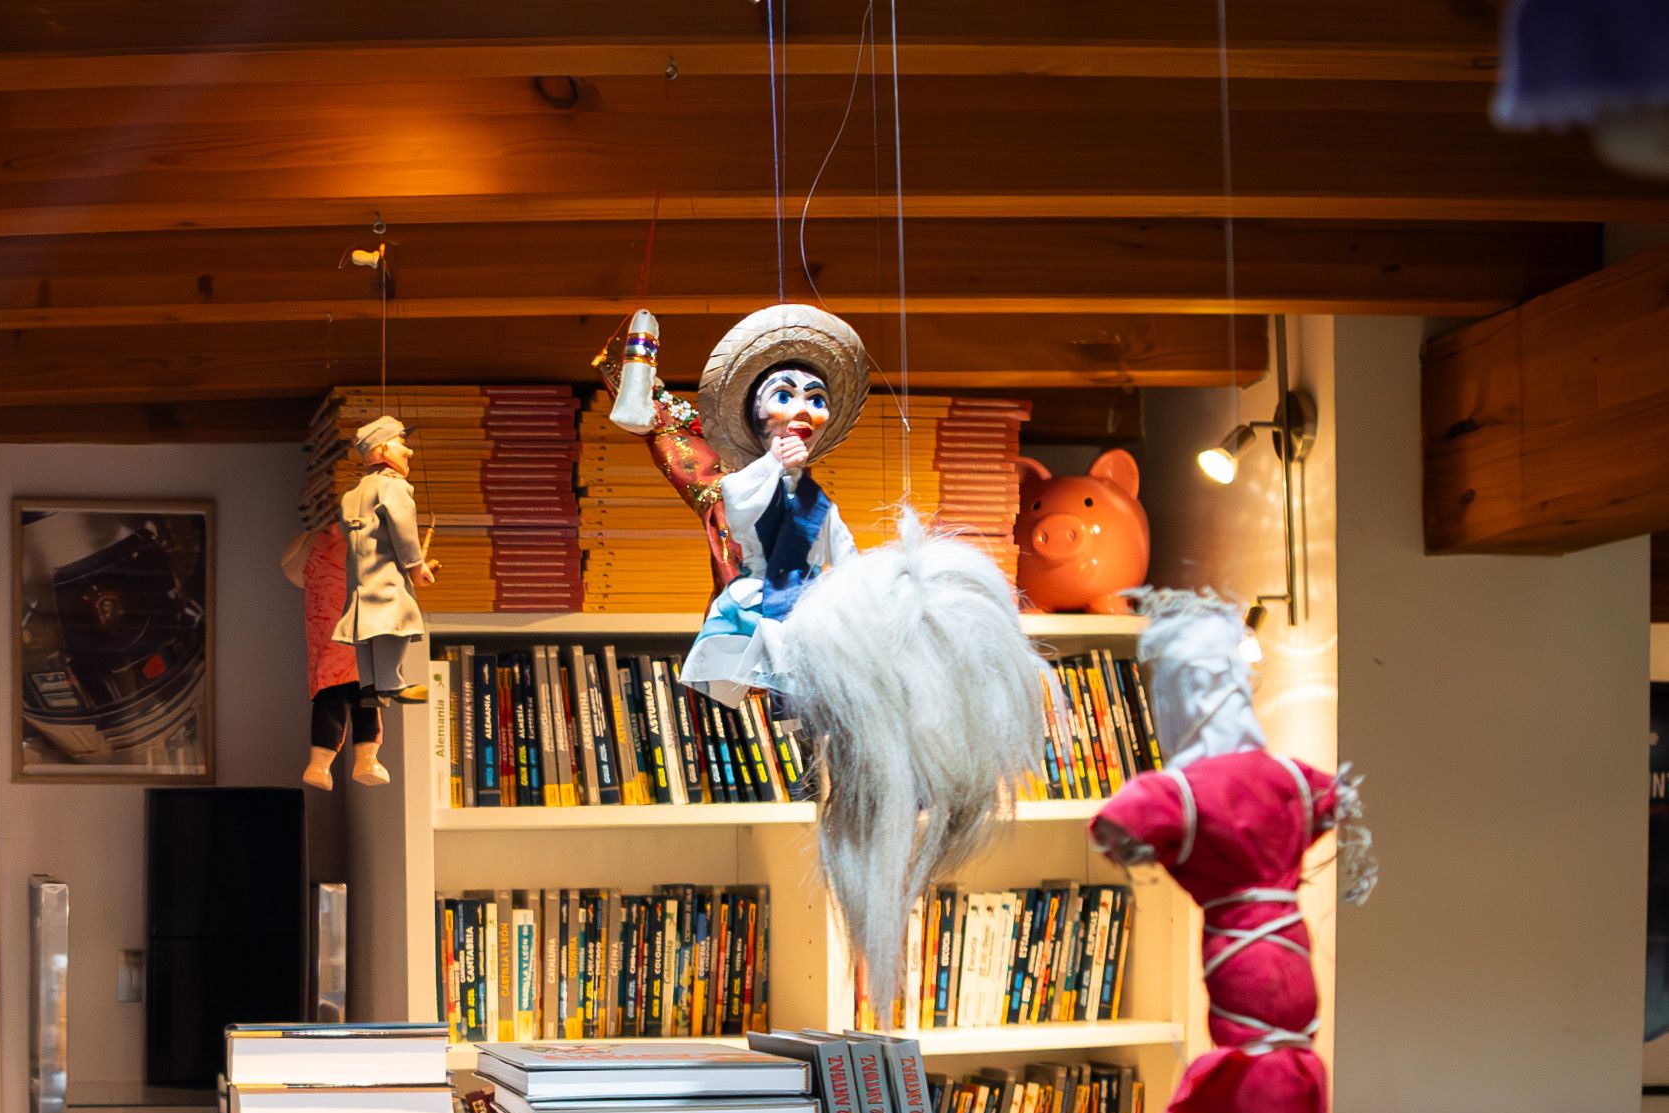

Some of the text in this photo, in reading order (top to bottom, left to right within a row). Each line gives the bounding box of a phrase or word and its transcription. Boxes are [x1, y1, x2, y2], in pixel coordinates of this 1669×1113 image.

[435, 699, 445, 758] Alemania
[580, 691, 593, 749] ARGENTINA
[643, 680, 660, 735] ASTURIAS
[466, 926, 475, 983] CANTABRIA
[610, 942, 618, 976] CHINA
[654, 931, 662, 974] COLOMBIA
